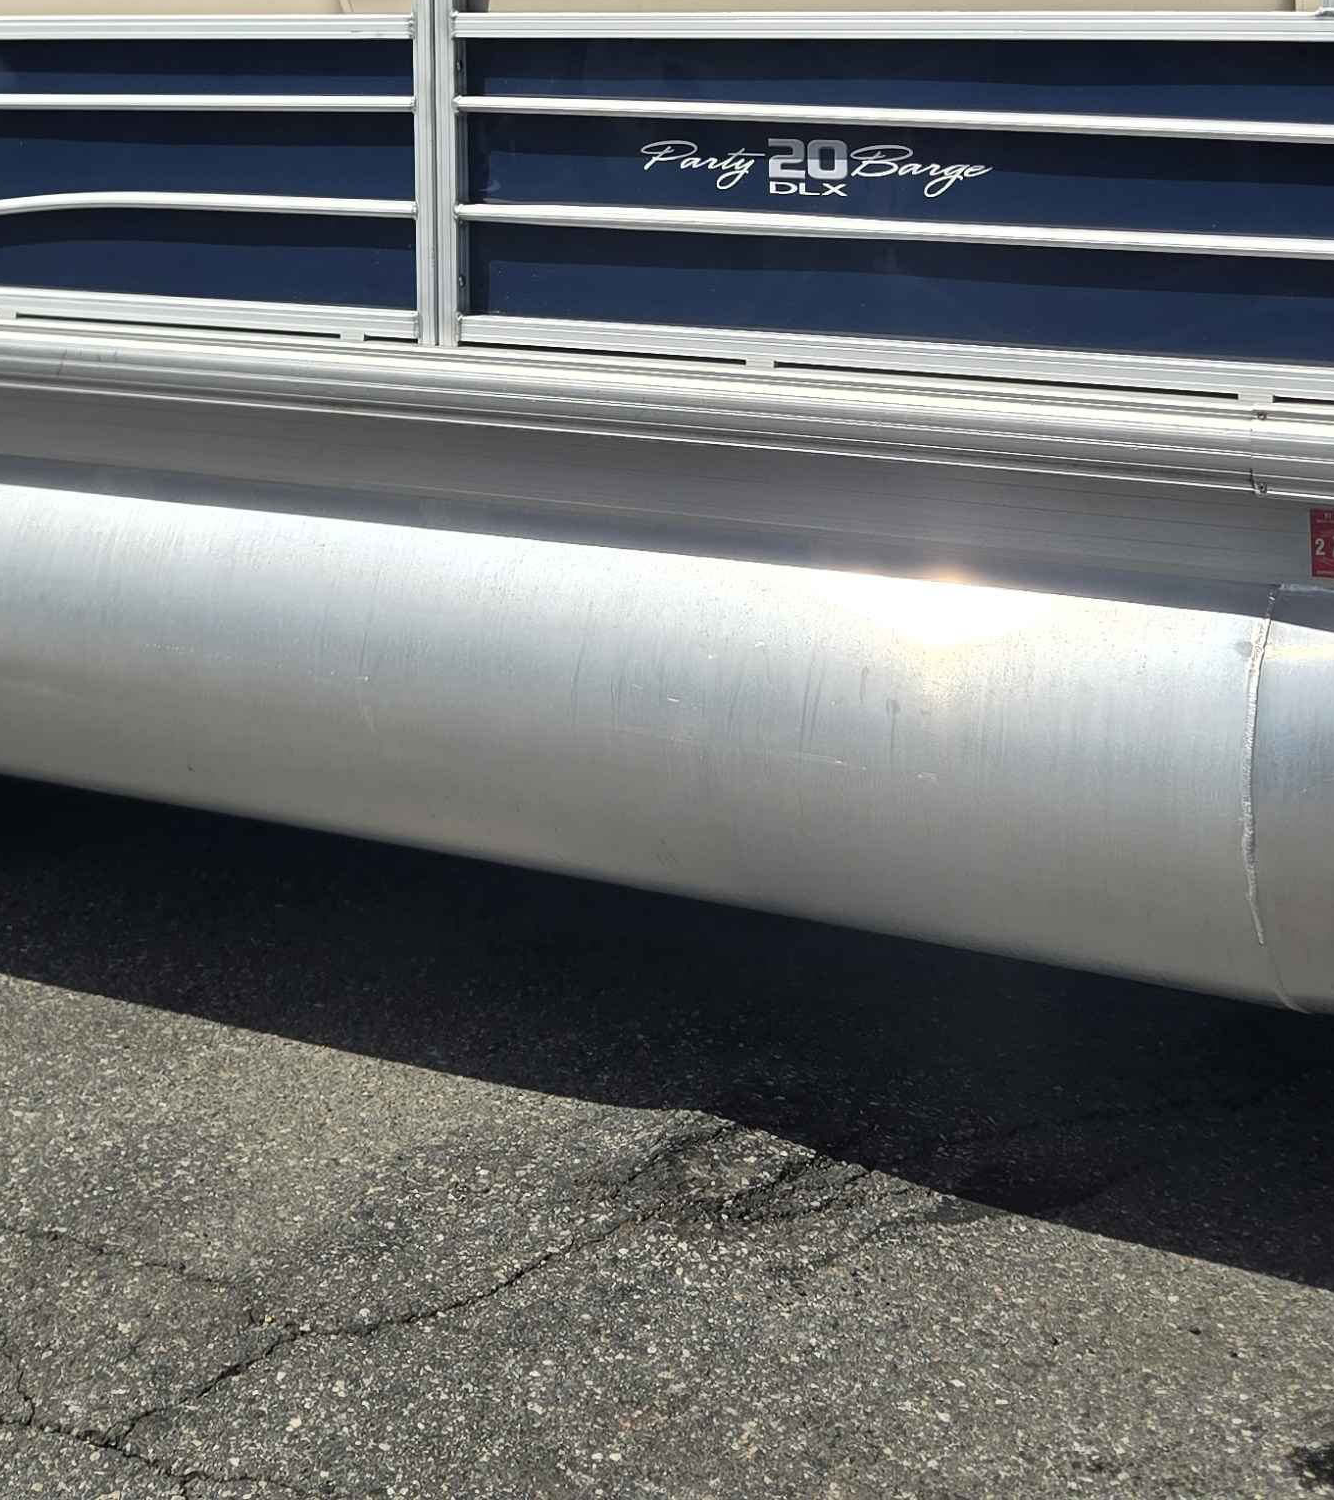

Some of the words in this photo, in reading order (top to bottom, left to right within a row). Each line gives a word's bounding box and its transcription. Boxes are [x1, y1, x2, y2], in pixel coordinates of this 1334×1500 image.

[641, 140, 765, 190] Party
[768, 138, 848, 180] 20
[850, 145, 993, 198] Barge
[769, 181, 848, 197] DLX
[1314, 537, 1326, 556] 2
